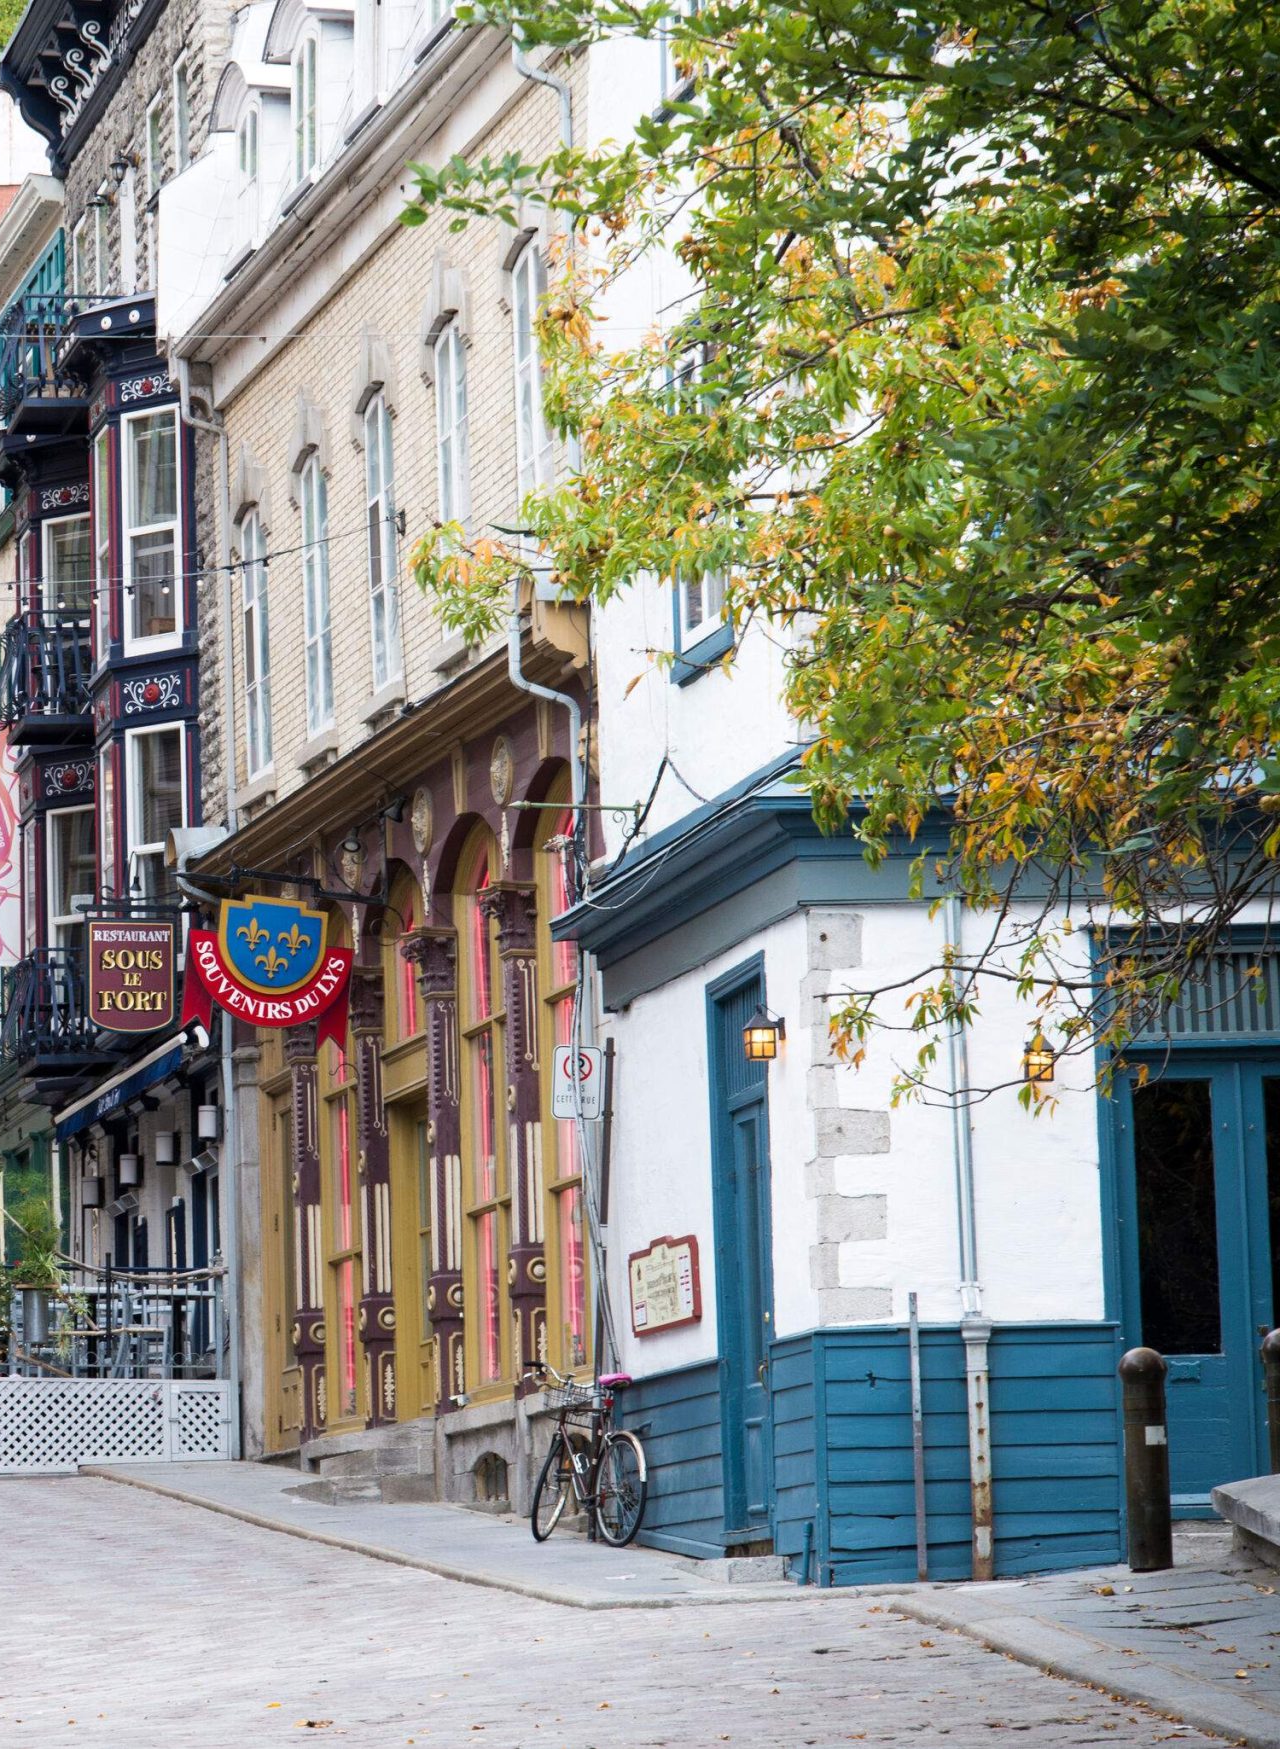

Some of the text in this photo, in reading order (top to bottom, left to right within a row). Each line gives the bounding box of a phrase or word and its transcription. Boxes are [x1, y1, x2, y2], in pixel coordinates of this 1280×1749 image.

[93, 930, 170, 942] RESTAURANT
[101, 949, 163, 970] SOUS
[122, 972, 142, 987] LE
[196, 940, 345, 1019] SOUVENIRS DU LYS
[98, 990, 167, 1011] FORT
[567, 1084, 585, 1093] DS
[556, 1095, 596, 1105] CETT RUE
